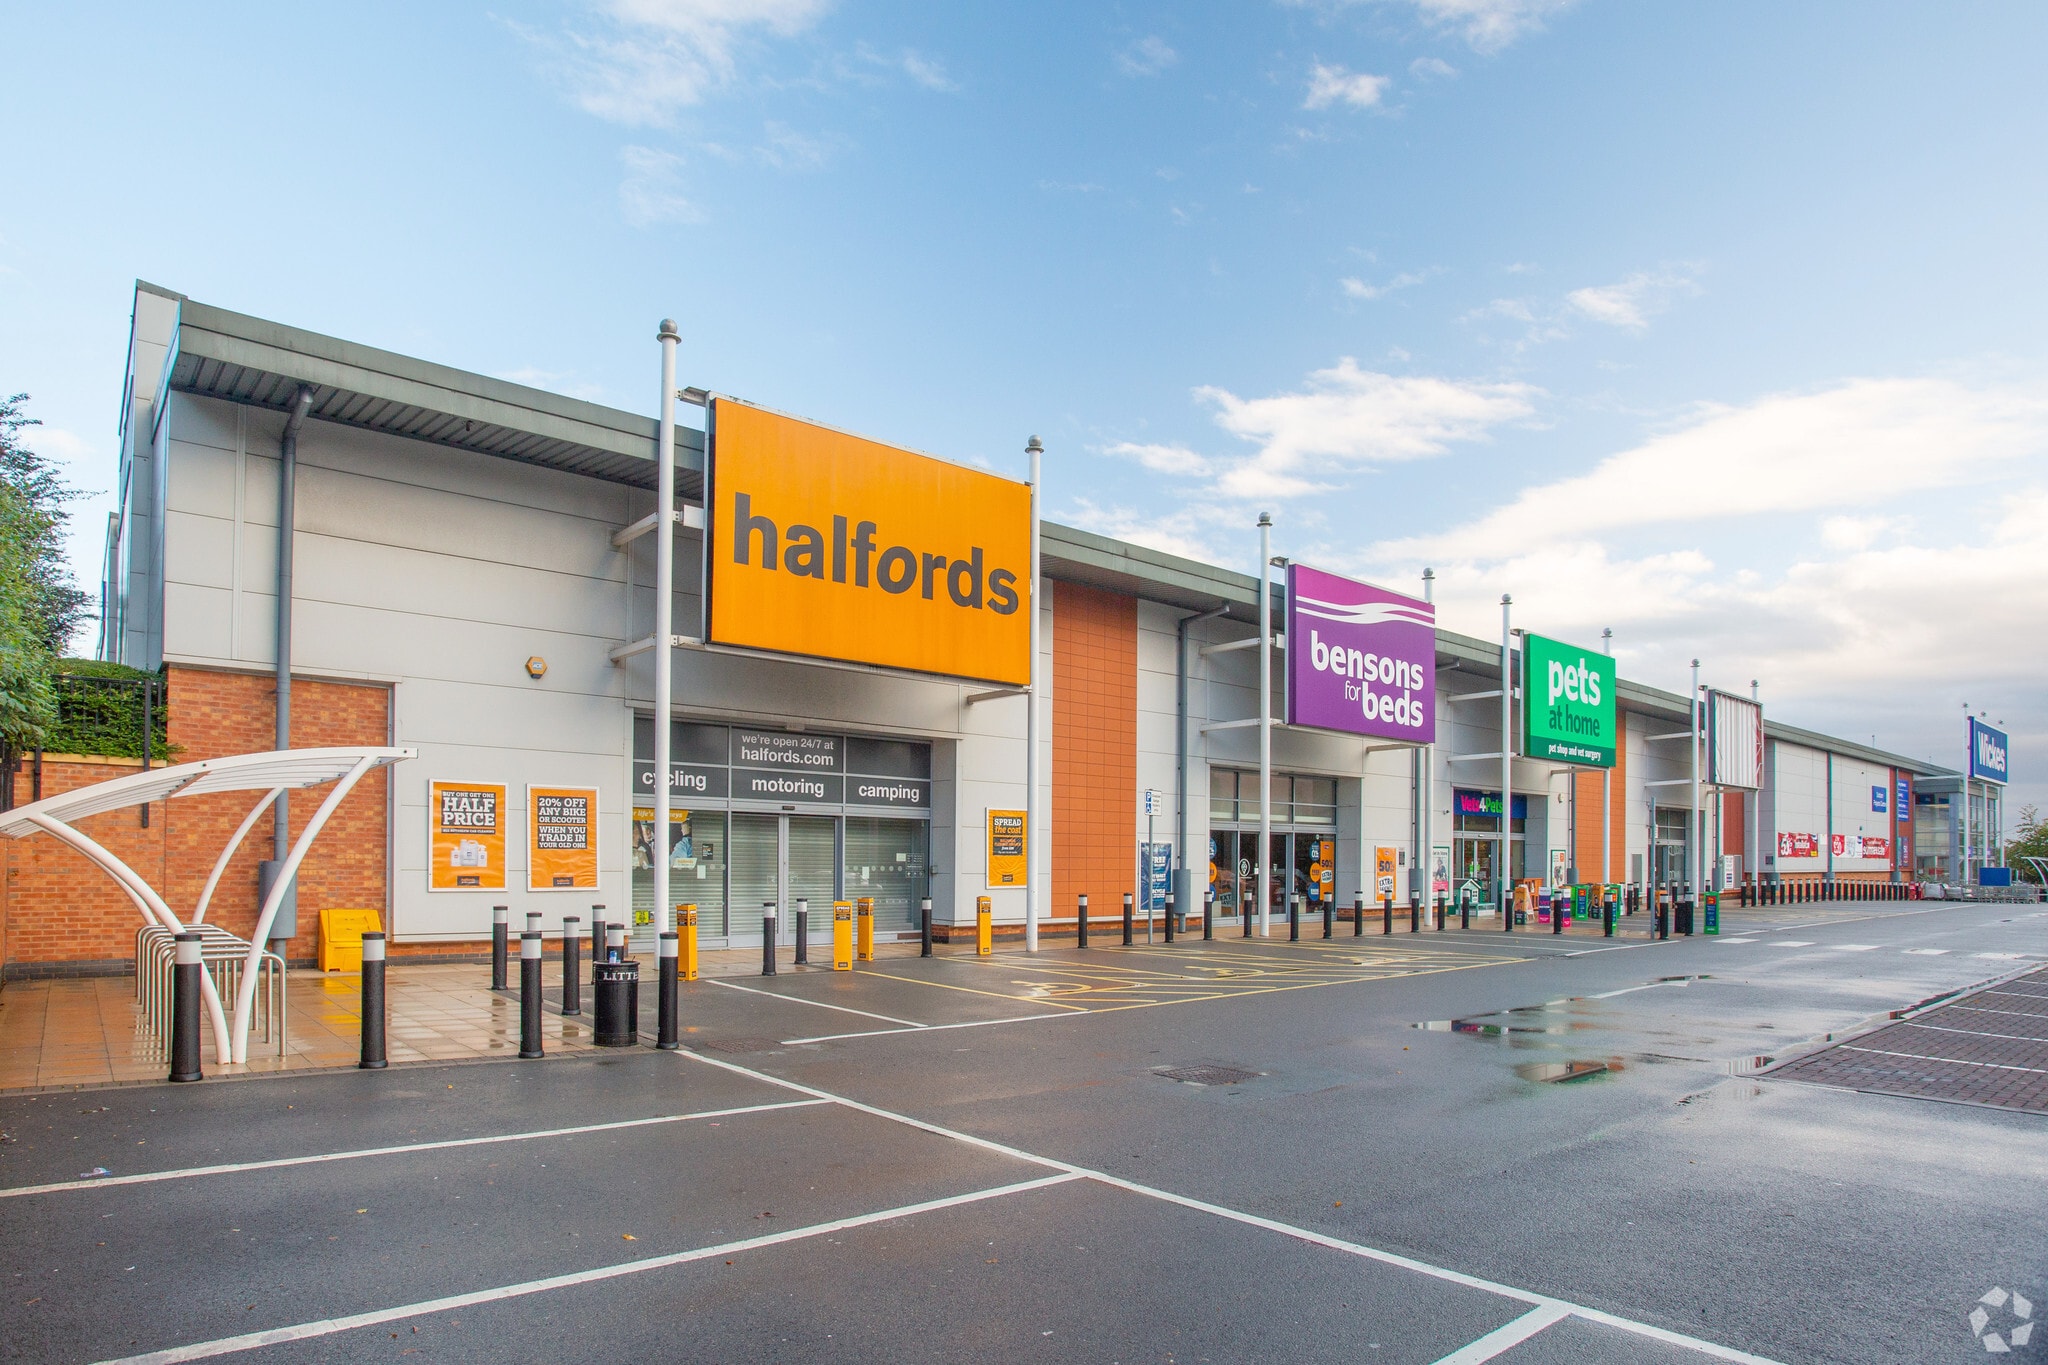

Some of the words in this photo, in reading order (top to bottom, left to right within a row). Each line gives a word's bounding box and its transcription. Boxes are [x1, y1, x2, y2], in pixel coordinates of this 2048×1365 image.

[733, 491, 1019, 616] halfords
[1311, 629, 1424, 691] bensons
[1548, 657, 1601, 706] pets
[1344, 680, 1361, 702] for
[1362, 681, 1424, 728] beds
[1549, 705, 1563, 731] at
[1565, 704, 1600, 737] home
[742, 734, 770, 745] we're
[773, 736, 798, 748] open
[800, 738, 821, 749] 24/7
[824, 741, 834, 750] at
[741, 746, 834, 766] halfords.com
[1548, 744, 1557, 754] pet
[1557, 743, 1568, 757] shop
[1569, 746, 1577, 756] and
[1585, 749, 1601, 761] surgery
[1977, 731, 2005, 772] Wickes
[642, 770, 707, 791] ccling
[752, 778, 824, 798] motoring
[858, 784, 920, 802] camping
[443, 797, 495, 812] HALF
[539, 798, 562, 807] 20%
[564, 798, 586, 807] OFF
[539, 807, 562, 816] ANY
[563, 808, 586, 816] BIKE
[443, 812, 495, 826] PRICE
[994, 818, 1022, 826] SPREAD
[539, 826, 566, 834] WHEN
[568, 826, 586, 834] YOU
[539, 834, 573, 842] TRADE
[575, 834, 585, 842] IN
[1007, 826, 1021, 834] cost
[1379, 878, 1393, 886] EXTRA
